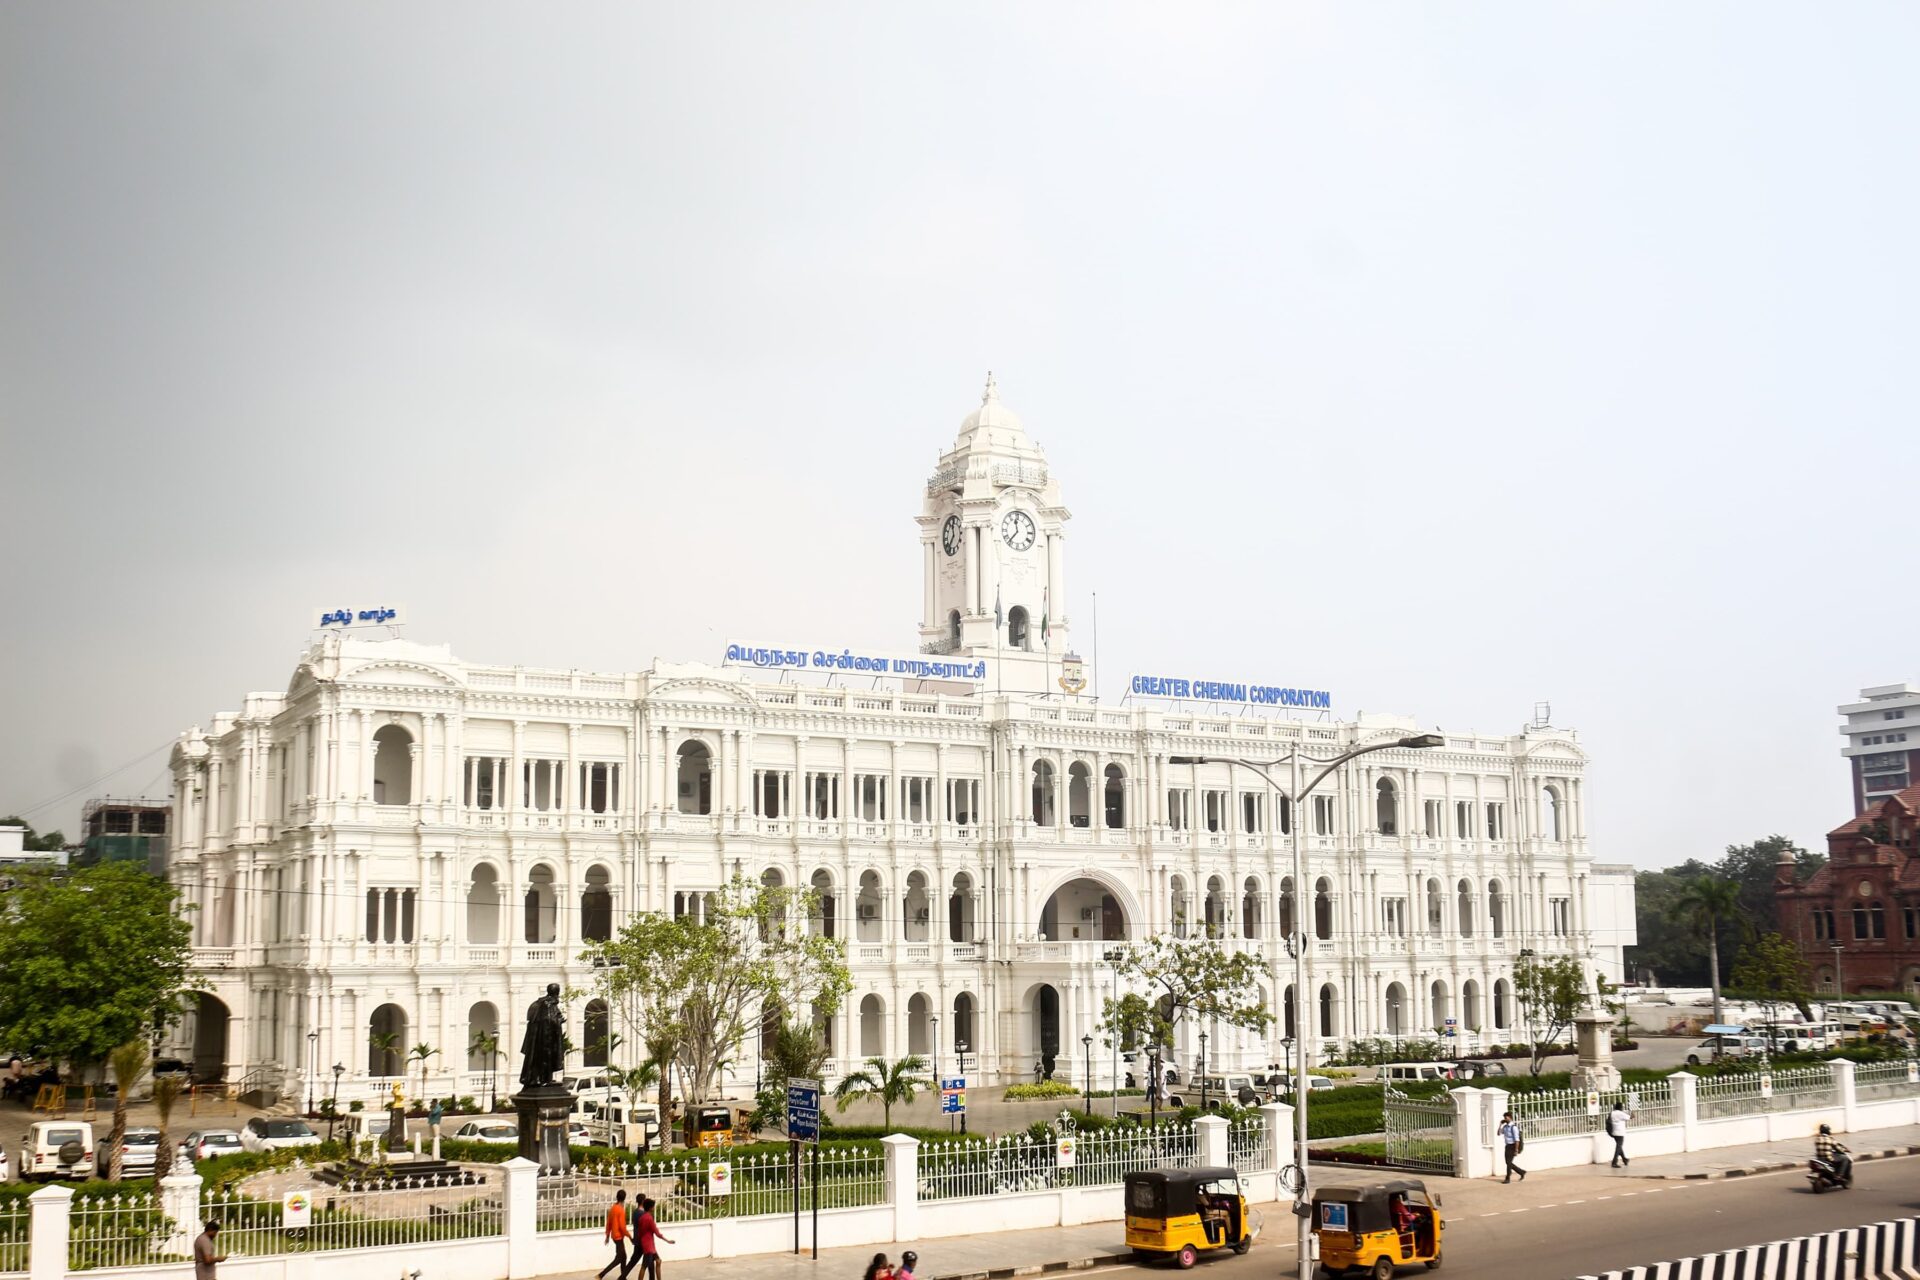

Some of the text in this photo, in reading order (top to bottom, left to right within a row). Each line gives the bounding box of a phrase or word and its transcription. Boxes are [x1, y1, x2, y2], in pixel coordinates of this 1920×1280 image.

[320, 606, 396, 627] தமிழ் வாழ்க
[727, 644, 985, 679] பெருநகர சென்னை மாநகராட்சி
[1132, 675, 1330, 708] GREATER CHENNAI CORPORATION
